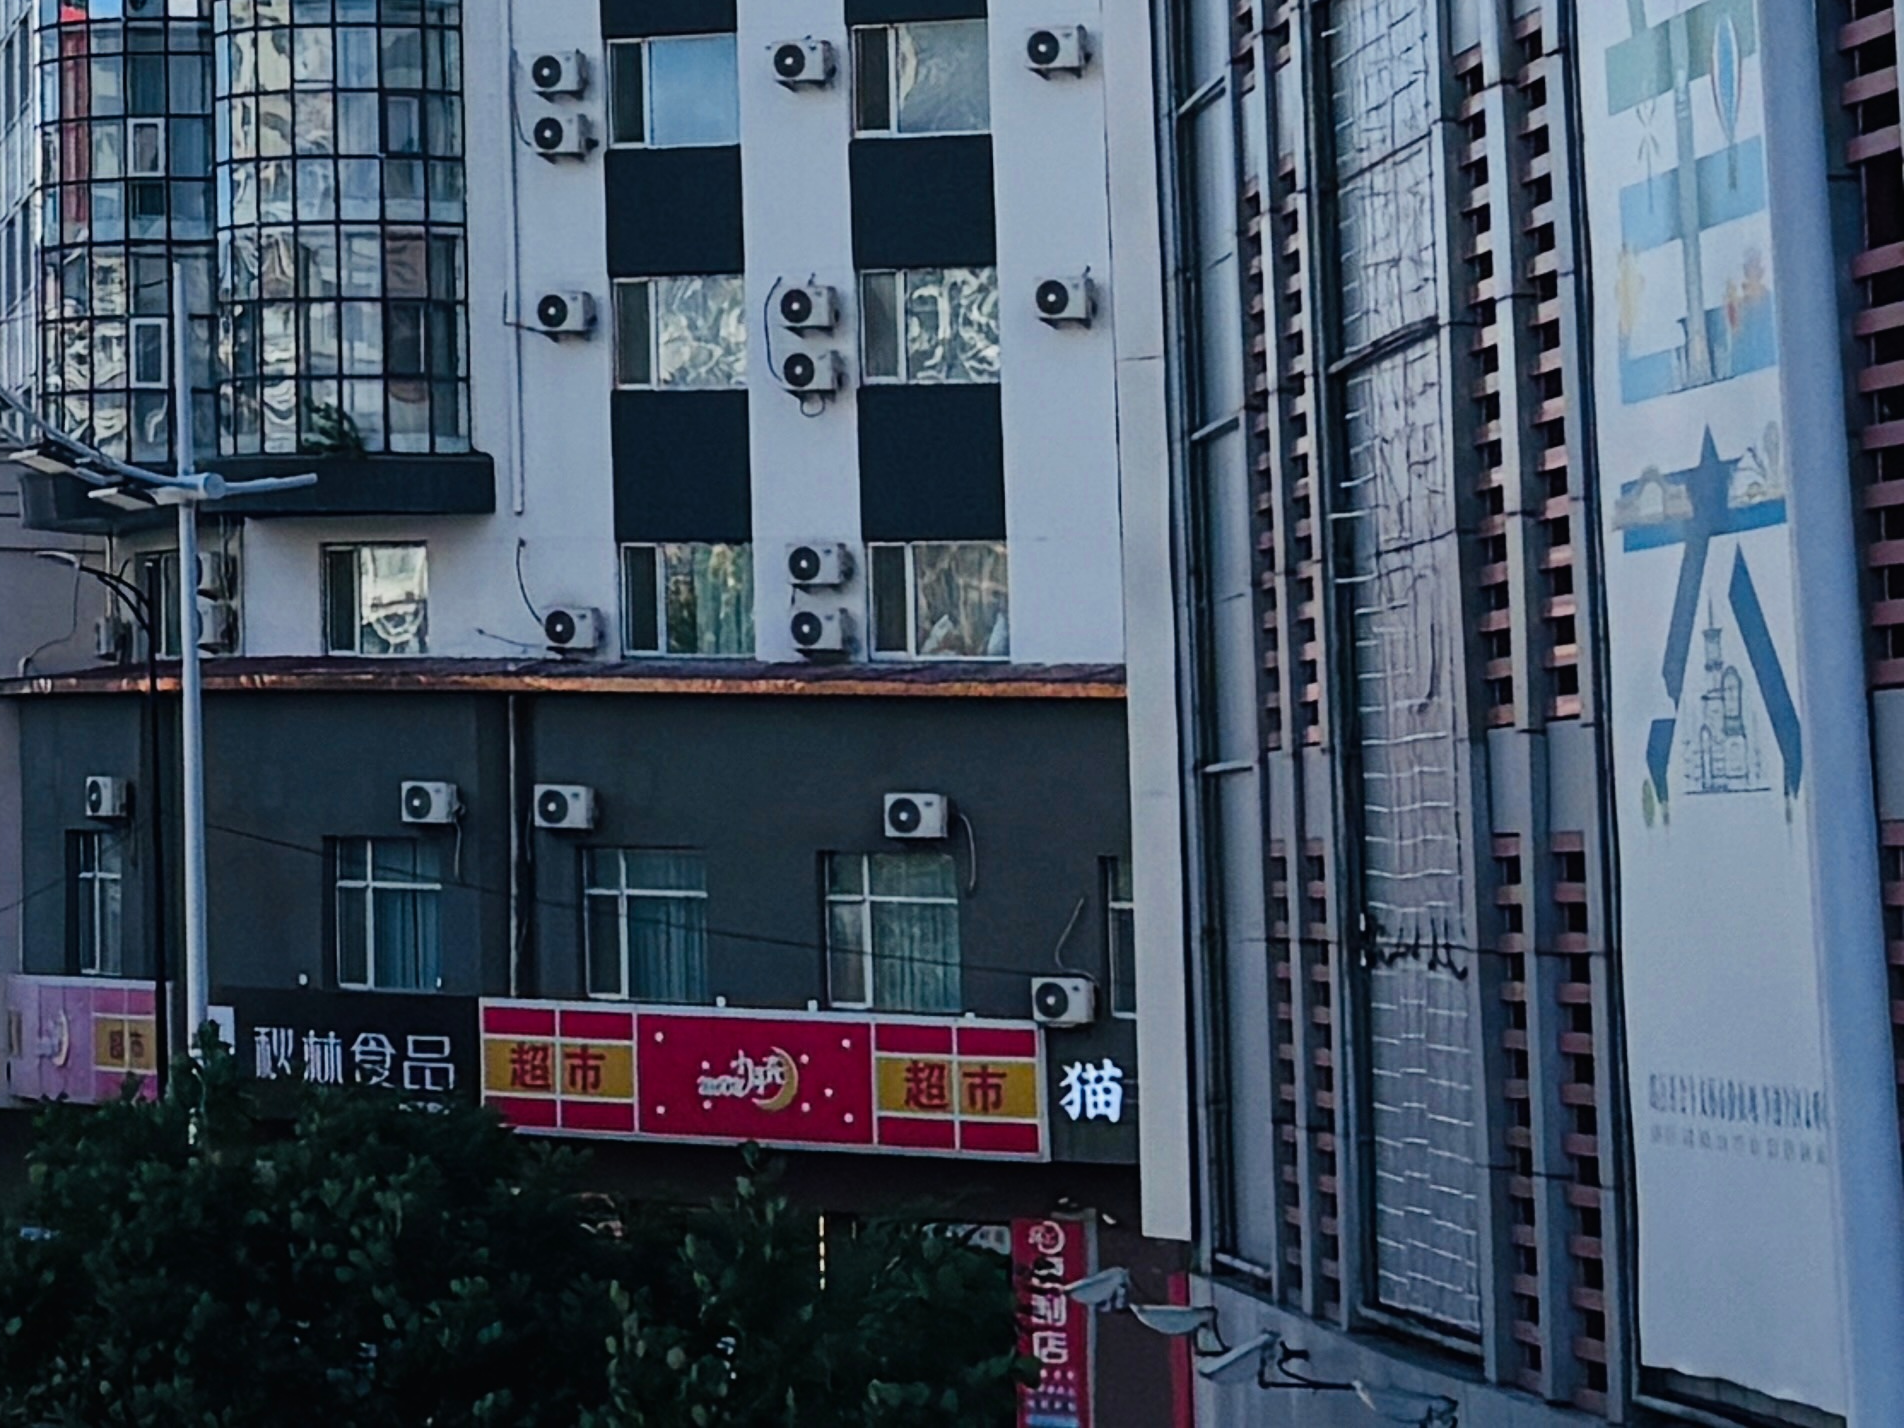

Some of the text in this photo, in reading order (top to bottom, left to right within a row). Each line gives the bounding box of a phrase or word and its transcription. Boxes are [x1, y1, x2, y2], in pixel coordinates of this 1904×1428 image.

[254, 1025, 455, 1092] 秋林食品
[509, 1041, 607, 1093] 超市
[904, 1058, 1008, 1114] 超市
[1058, 1057, 1124, 1124] 猫
